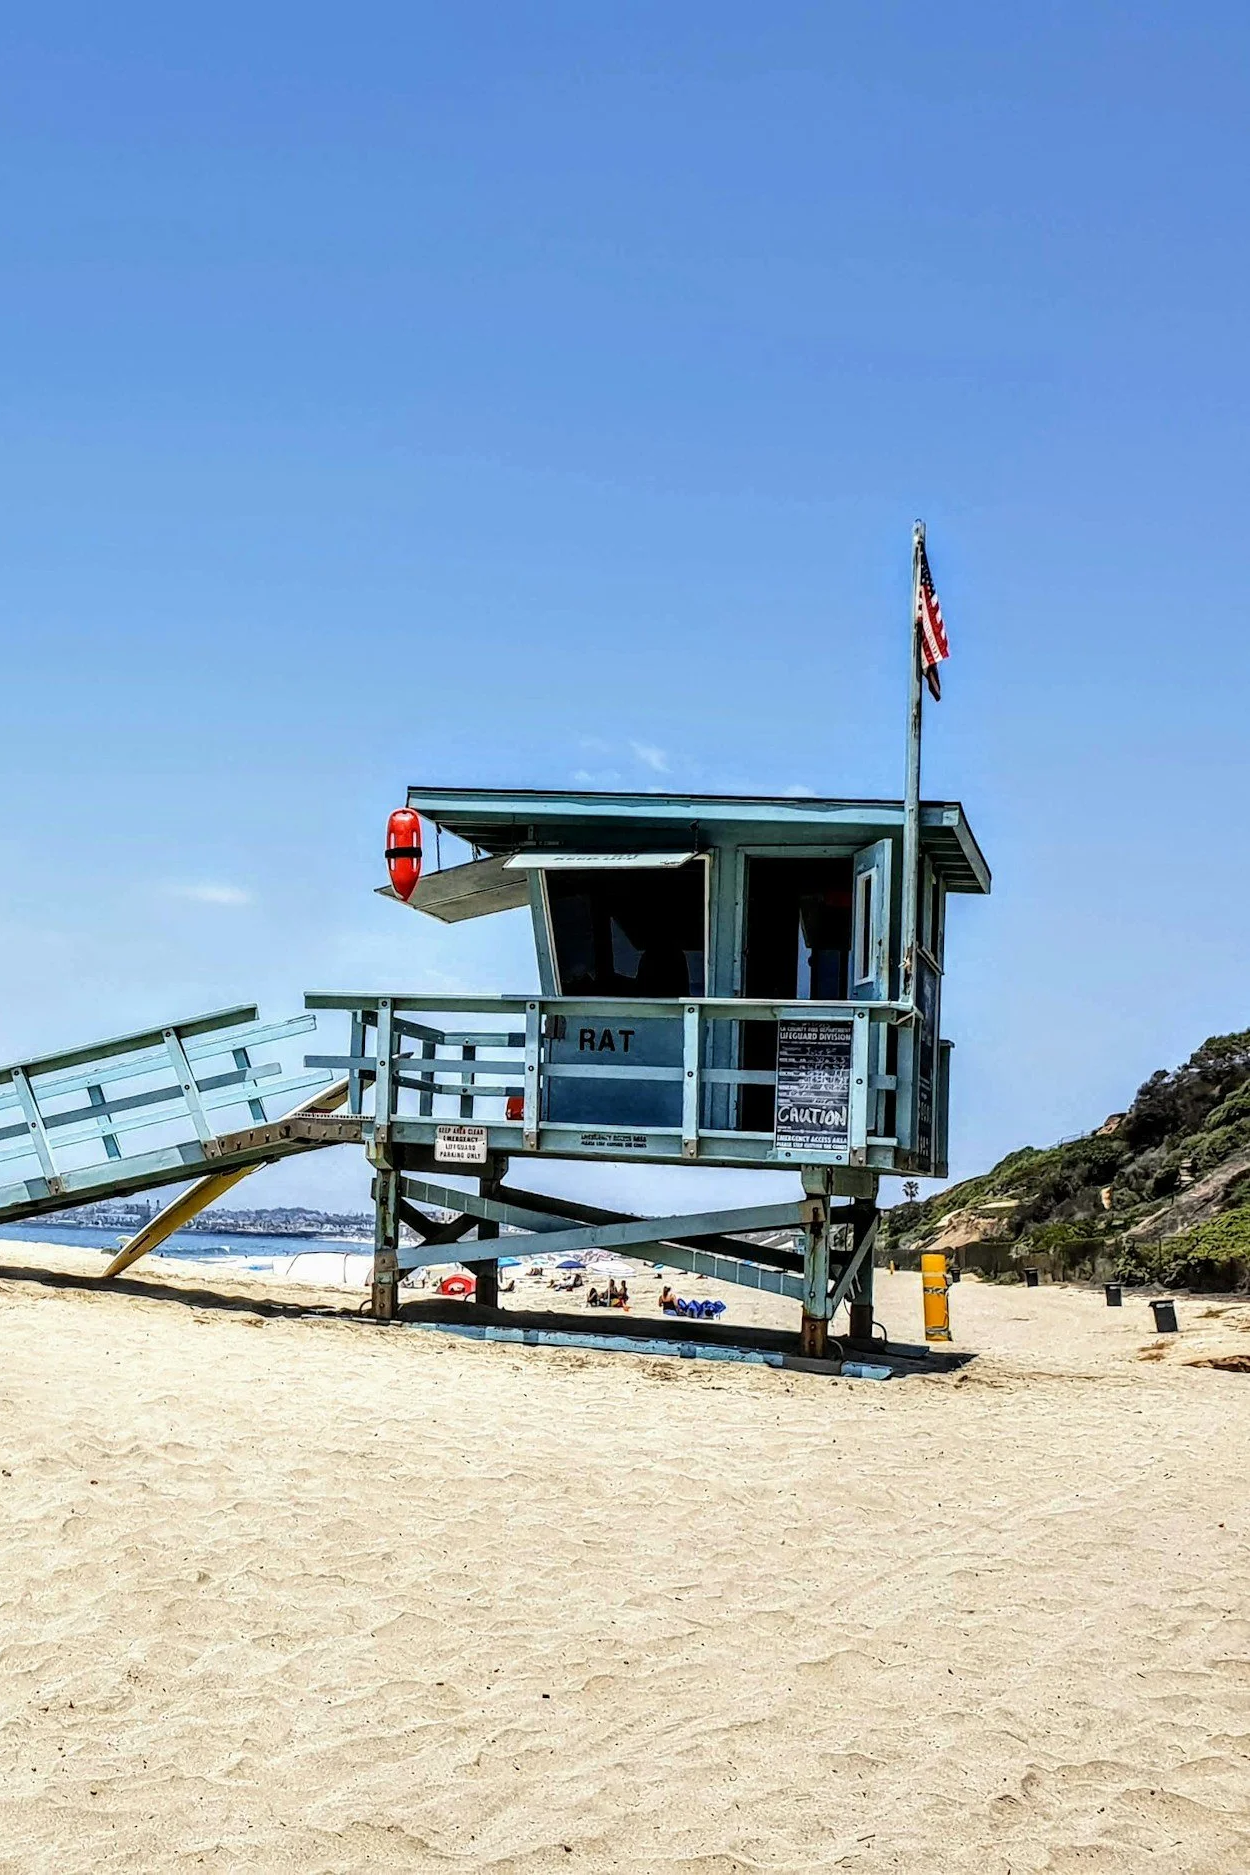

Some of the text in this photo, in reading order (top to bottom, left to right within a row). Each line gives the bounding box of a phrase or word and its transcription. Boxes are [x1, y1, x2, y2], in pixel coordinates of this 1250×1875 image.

[579, 1028, 635, 1053] RAT
[779, 1032, 851, 1041] LIFEGUARD DIVISION
[778, 1106, 847, 1126] CAUTION
